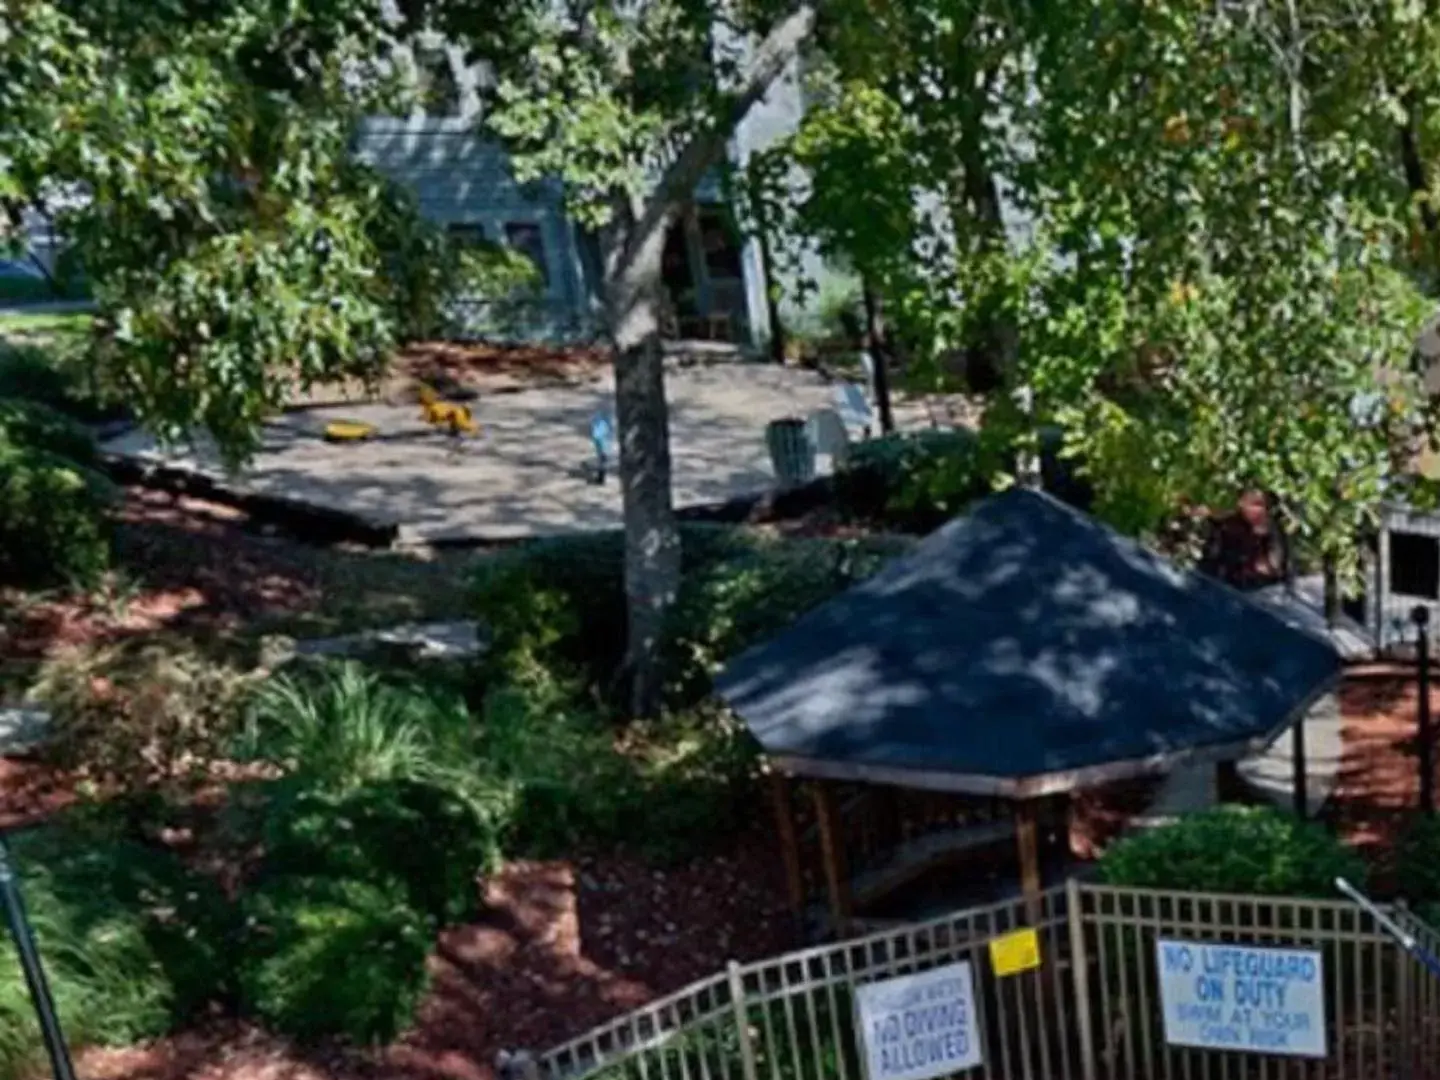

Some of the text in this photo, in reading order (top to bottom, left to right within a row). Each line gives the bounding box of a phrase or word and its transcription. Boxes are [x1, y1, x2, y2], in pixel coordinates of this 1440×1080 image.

[1164, 946, 1316, 982] NO LIFEGUARD
[1196, 974, 1287, 1007] ON DUTY
[873, 997, 966, 1044] NO DIVING
[881, 1029, 969, 1074] ALLOWED
